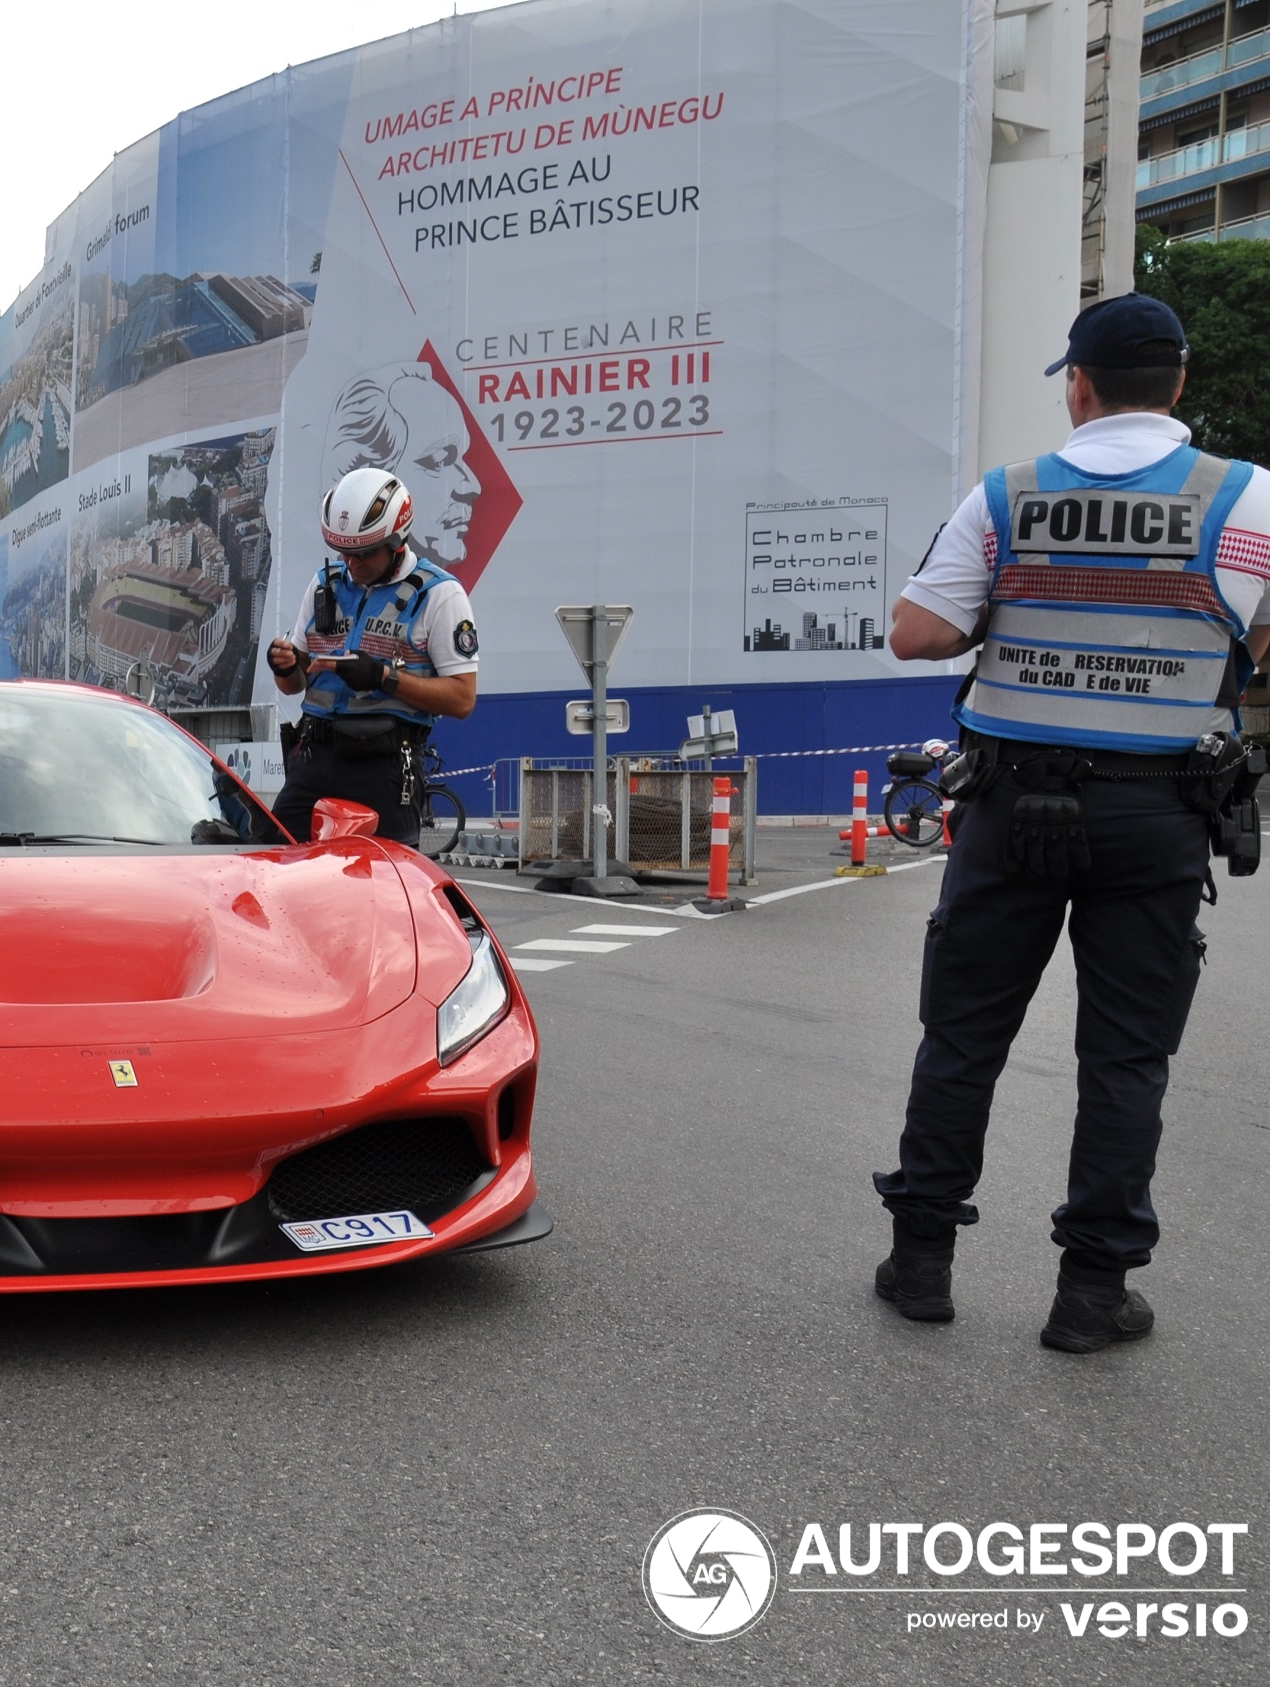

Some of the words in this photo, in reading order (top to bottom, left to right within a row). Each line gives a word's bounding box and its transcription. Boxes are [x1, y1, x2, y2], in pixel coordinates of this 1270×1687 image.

[364, 99, 455, 144] UMAGE
[460, 97, 479, 121] A
[378, 128, 526, 181] ARCHITETU
[533, 120, 574, 149] DE
[581, 92, 724, 141] MÙNEGU
[397, 164, 559, 216] HOMMAGE
[567, 154, 612, 186] AU
[114, 205, 150, 235] forum
[415, 212, 520, 253] PRINCE
[530, 185, 700, 235] BÂTISSEUR
[455, 312, 713, 363] CENTENAIRE
[478, 358, 651, 404] RAINIER
[671, 352, 710, 386] III
[490, 394, 710, 443] 1923-2023
[78, 488, 97, 512] Stade
[99, 479, 121, 502] Louis
[124, 474, 131, 494] II
[745, 499, 818, 511] Principauté
[821, 498, 836, 506] de
[839, 496, 889, 504] Monaco
[11, 525, 26, 549] Digue
[26, 507, 62, 534] semi-flottante
[328, 534, 358, 544] POLICE
[752, 527, 878, 545] Chambre
[1017, 498, 1193, 546] POLICE
[752, 551, 878, 570] Patronale
[751, 584, 769, 594] du
[772, 575, 877, 593] Bâtiment
[998, 646, 1036, 666] UNITE
[1039, 652, 1061, 668] de
[1018, 668, 1039, 684] du
[1098, 675, 1121, 691] de
[1124, 677, 1151, 694] VIE
[320, 1213, 412, 1241] C917
